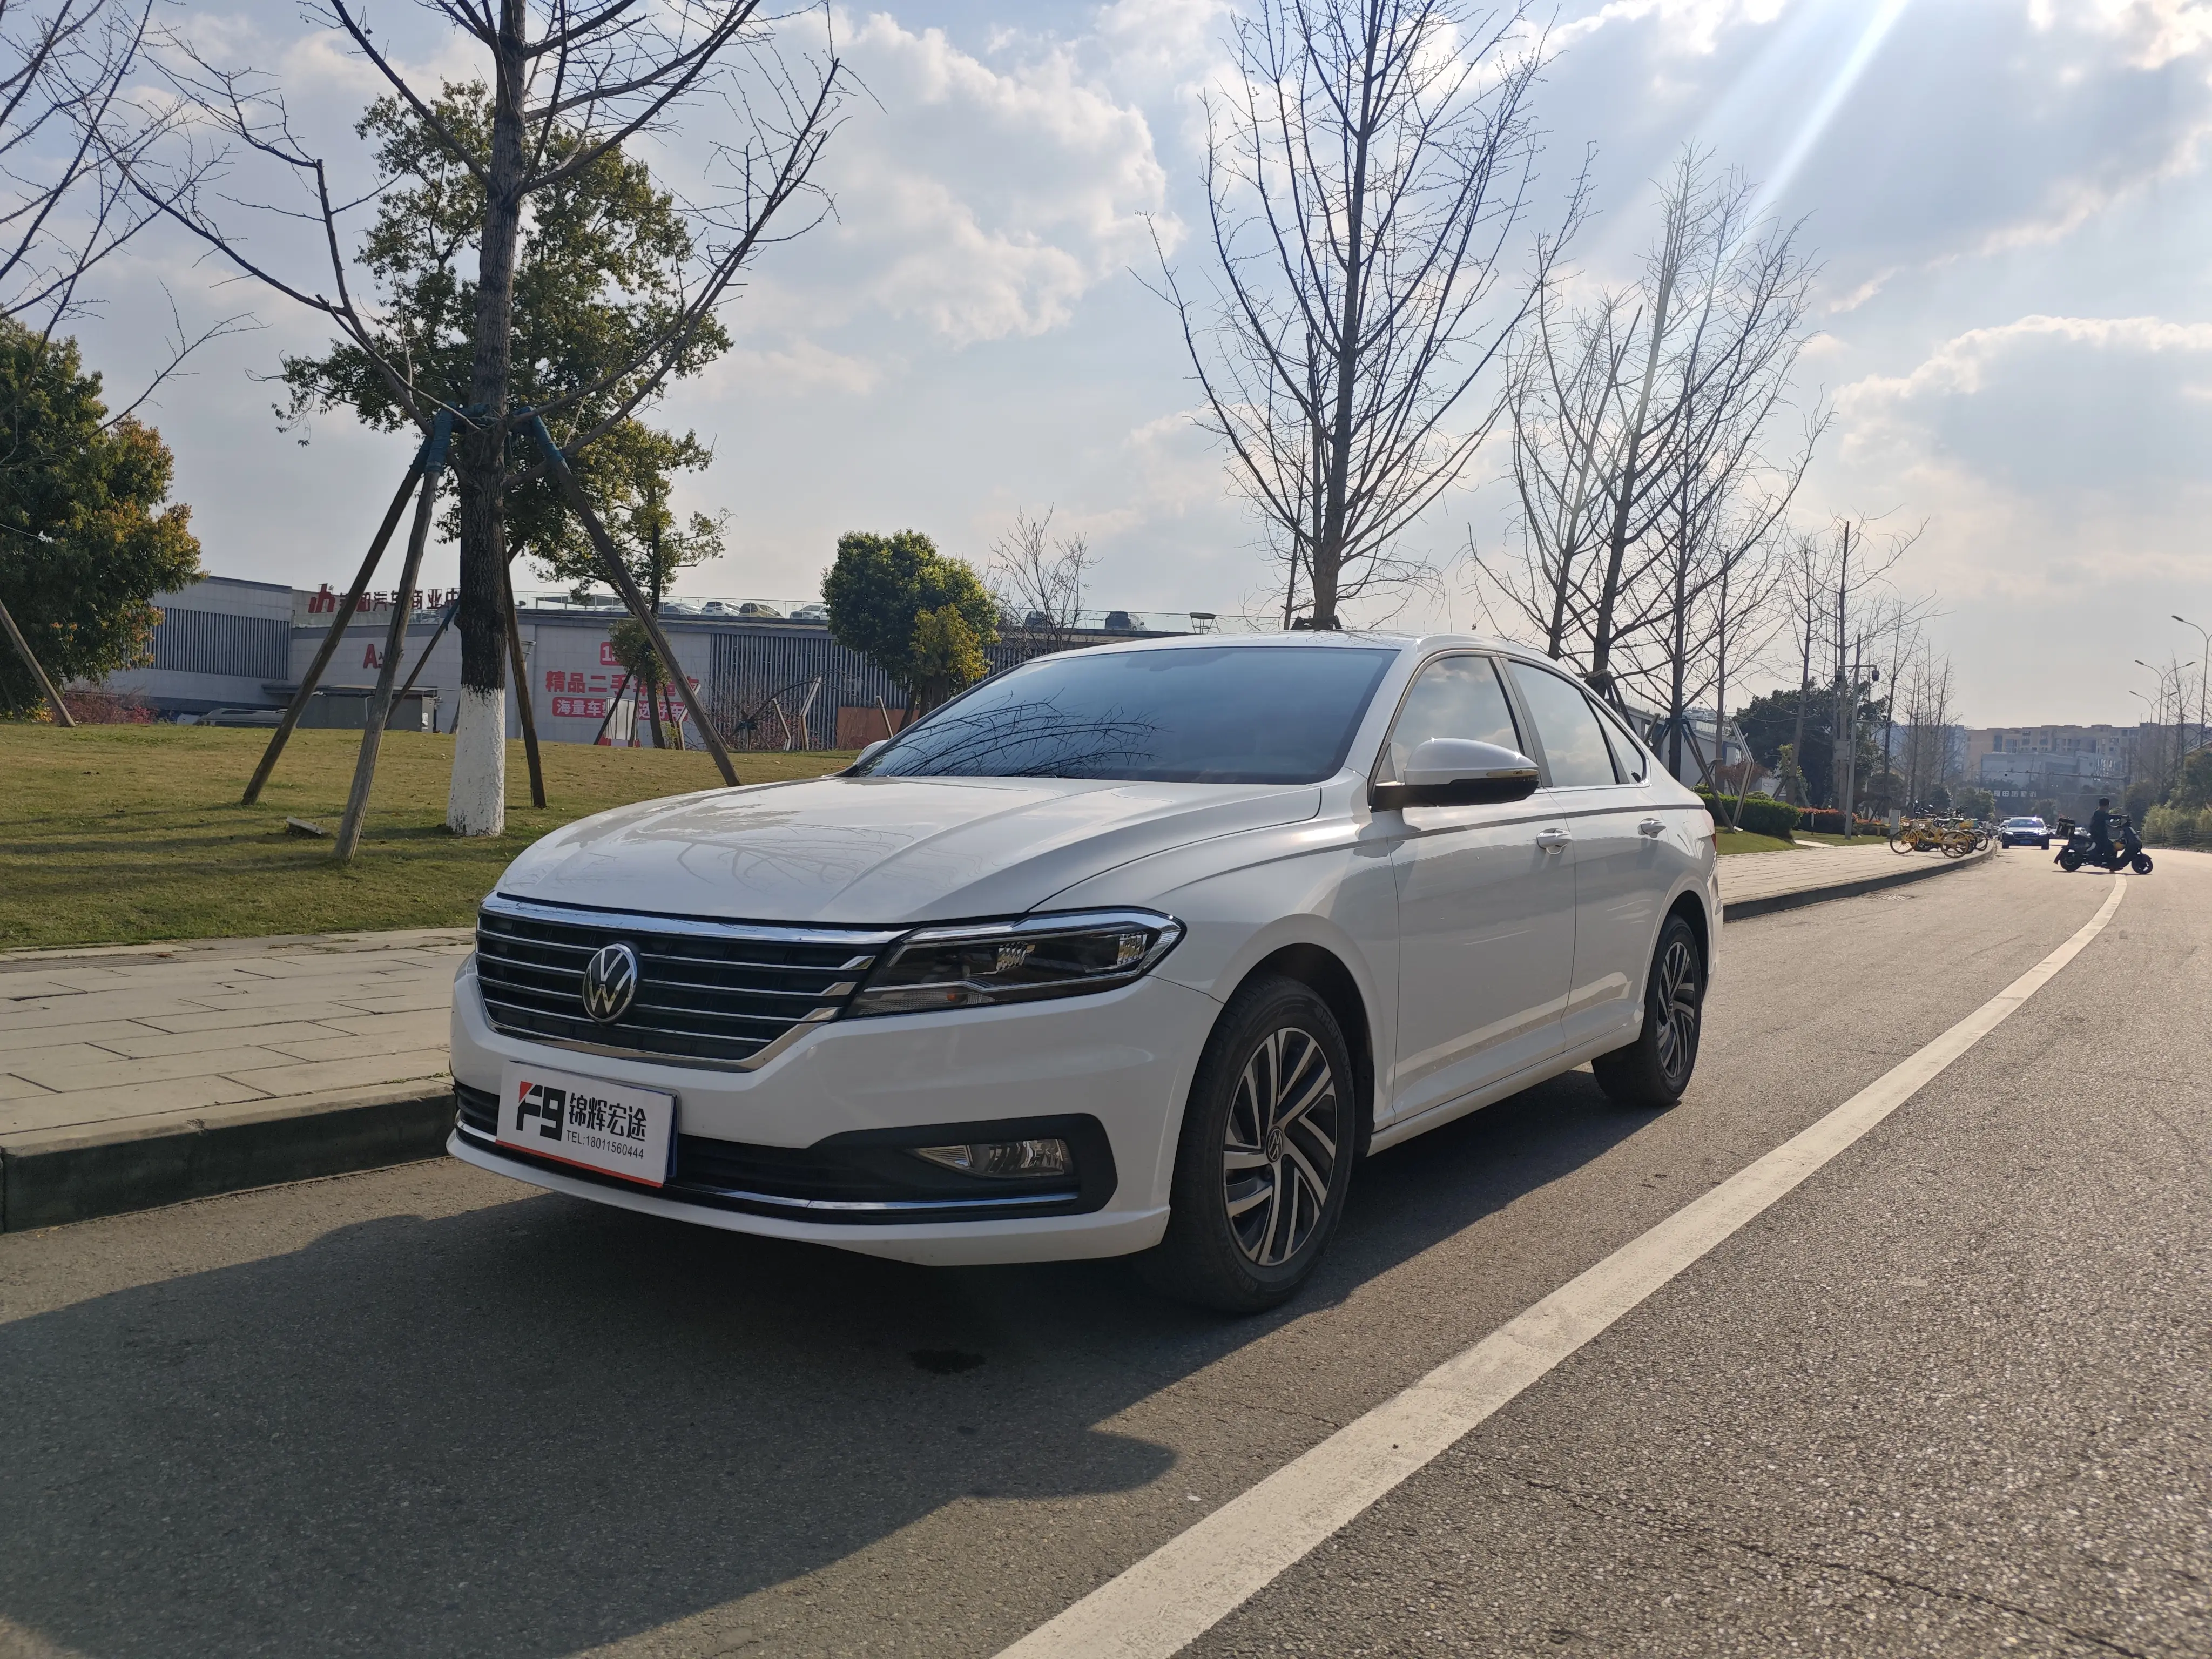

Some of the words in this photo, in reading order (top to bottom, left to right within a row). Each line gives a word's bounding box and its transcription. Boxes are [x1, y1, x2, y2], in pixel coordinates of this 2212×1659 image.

[569, 1092, 647, 1142] 锦辉宏途
[566, 1129, 644, 1160] TEL:18011560444
